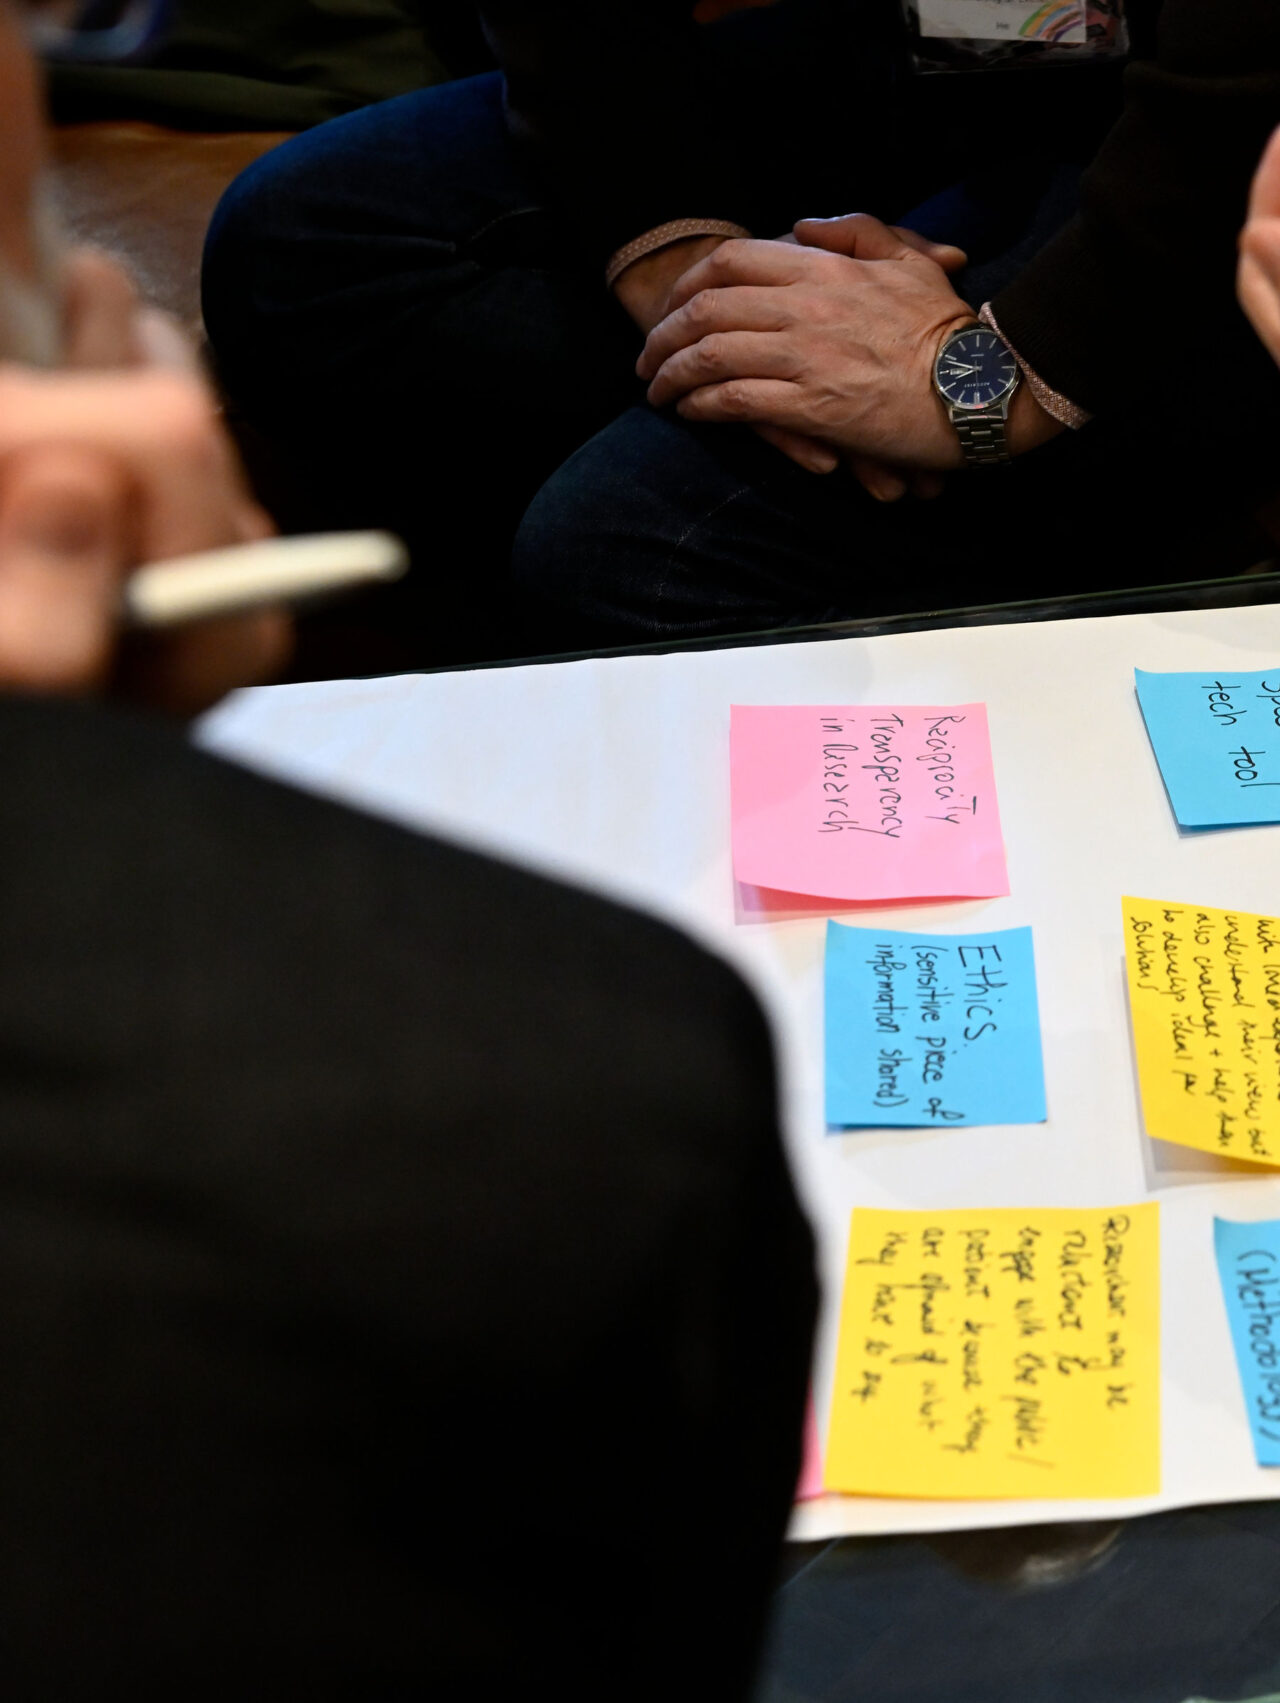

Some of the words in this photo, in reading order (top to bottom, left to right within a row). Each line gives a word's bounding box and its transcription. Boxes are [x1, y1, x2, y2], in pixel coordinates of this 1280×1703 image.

[820, 718, 855, 733] in
[1201, 681, 1247, 726] tech
[1163, 909, 1184, 923] to
[1193, 912, 1217, 945] also
[1257, 919, 1280, 953] with
[1224, 915, 1256, 1007] understand
[865, 944, 908, 1033] information
[911, 946, 955, 1022] (sensitive
[1187, 957, 1223, 1038] challenge
[872, 1049, 912, 1108] shared)
[915, 1036, 957, 1083] piece
[1205, 1068, 1234, 1103] help
[922, 1097, 965, 1120] of
